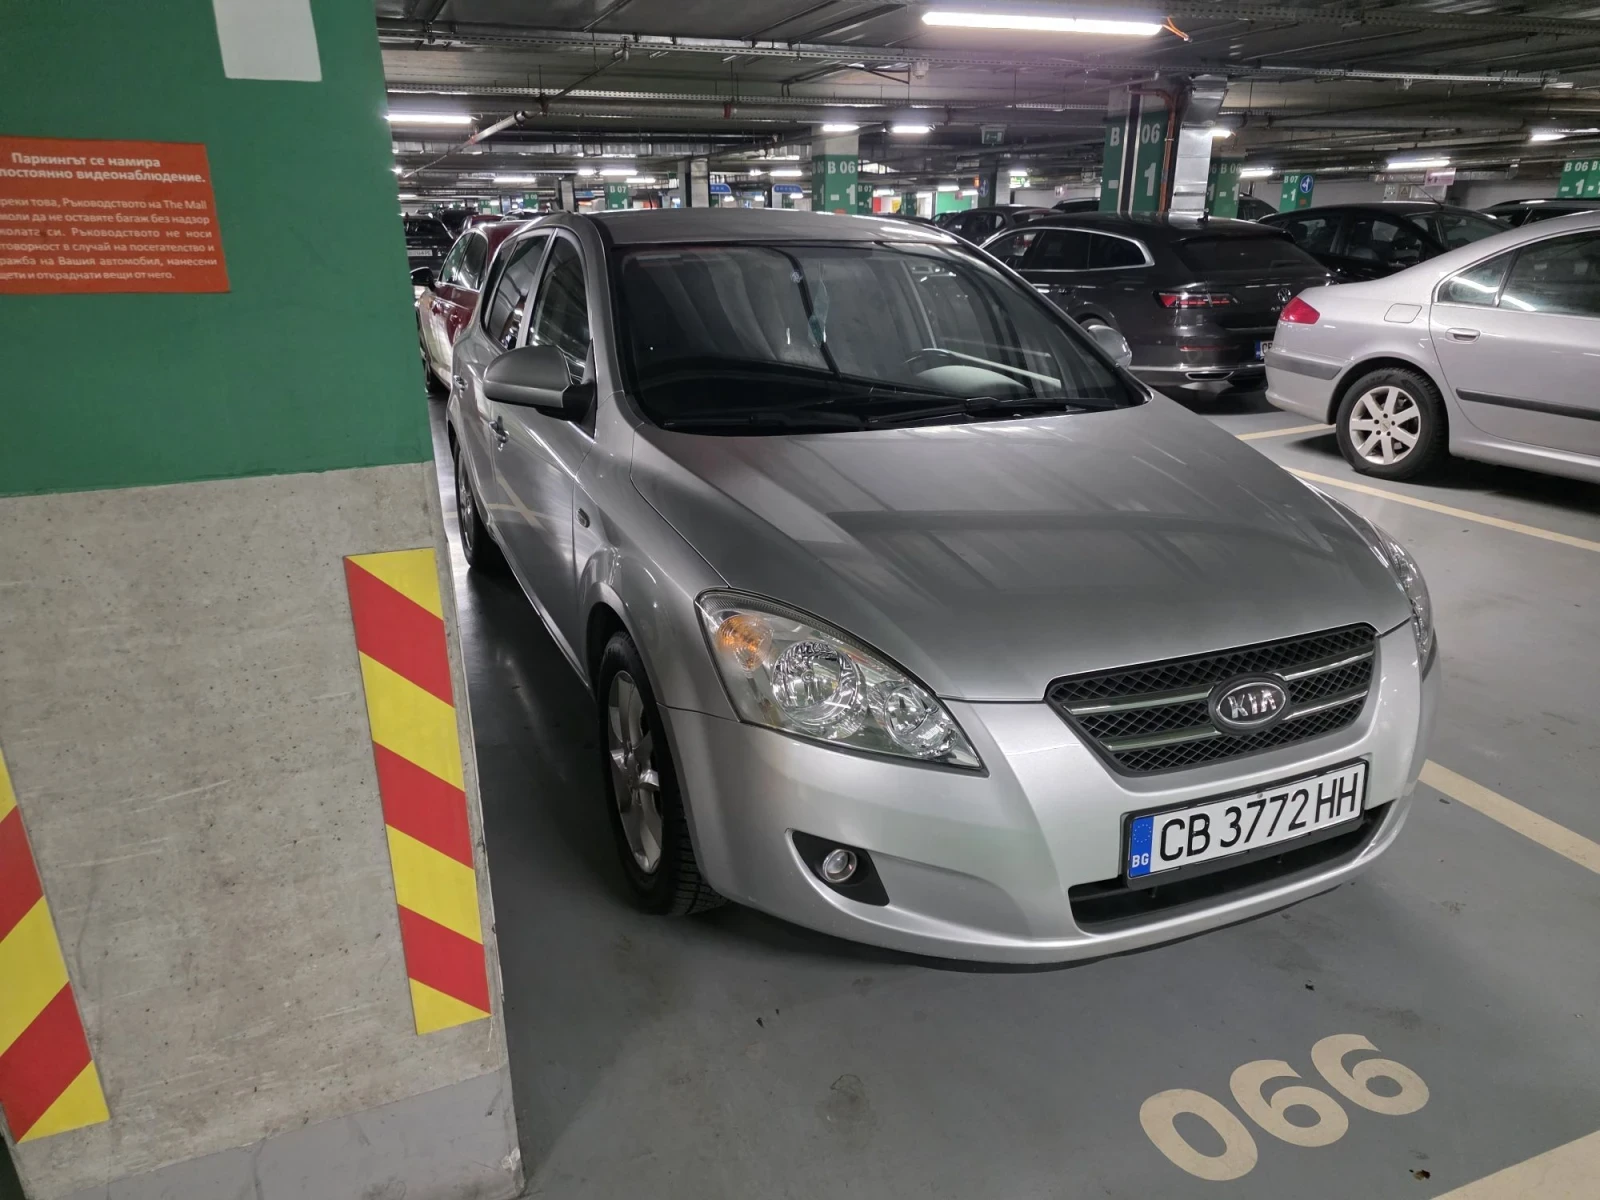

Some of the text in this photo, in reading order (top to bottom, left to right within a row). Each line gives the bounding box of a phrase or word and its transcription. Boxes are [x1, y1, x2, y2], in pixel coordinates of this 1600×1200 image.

[1110, 123, 1161, 147] B 06
[11, 152, 161, 169] Паркингът се намира
[1564, 162, 1573, 172] B
[1574, 161, 1589, 172] 06
[827, 161, 856, 175] B 06
[76, 169, 206, 183] видеонаблюдение.
[1290, 175, 1300, 183] 07
[30, 199, 60, 208] това,
[62, 197, 147, 209] Ръководството
[148, 201, 162, 209] на
[163, 200, 183, 209] The
[184, 200, 207, 210] Mall
[32, 214, 47, 222] да
[48, 214, 63, 222] не
[64, 214, 114, 222] оставяте
[115, 213, 149, 223] багаж
[150, 213, 170, 223] без
[171, 215, 210, 225] надзор
[46, 228, 66, 237] си.
[71, 227, 160, 238] Ръководството
[165, 230, 180, 238] не
[185, 230, 213, 238] носи
[63, 243, 70, 251] в
[72, 242, 111, 252] случай
[113, 244, 128, 252] на
[129, 244, 206, 252] посегателство
[207, 244, 215, 252] и
[40, 257, 55, 265] на
[57, 256, 96, 265] Вашия
[99, 256, 164, 266] автомобил,
[166, 258, 217, 266] нанесени
[36, 272, 102, 281] откраднати
[103, 272, 133, 280] вещи
[1228, 689, 1278, 719] KIA
[1159, 772, 1359, 862] CB 3772 HH
[1132, 854, 1149, 868] BG
[1139, 1033, 1430, 1181] 066
